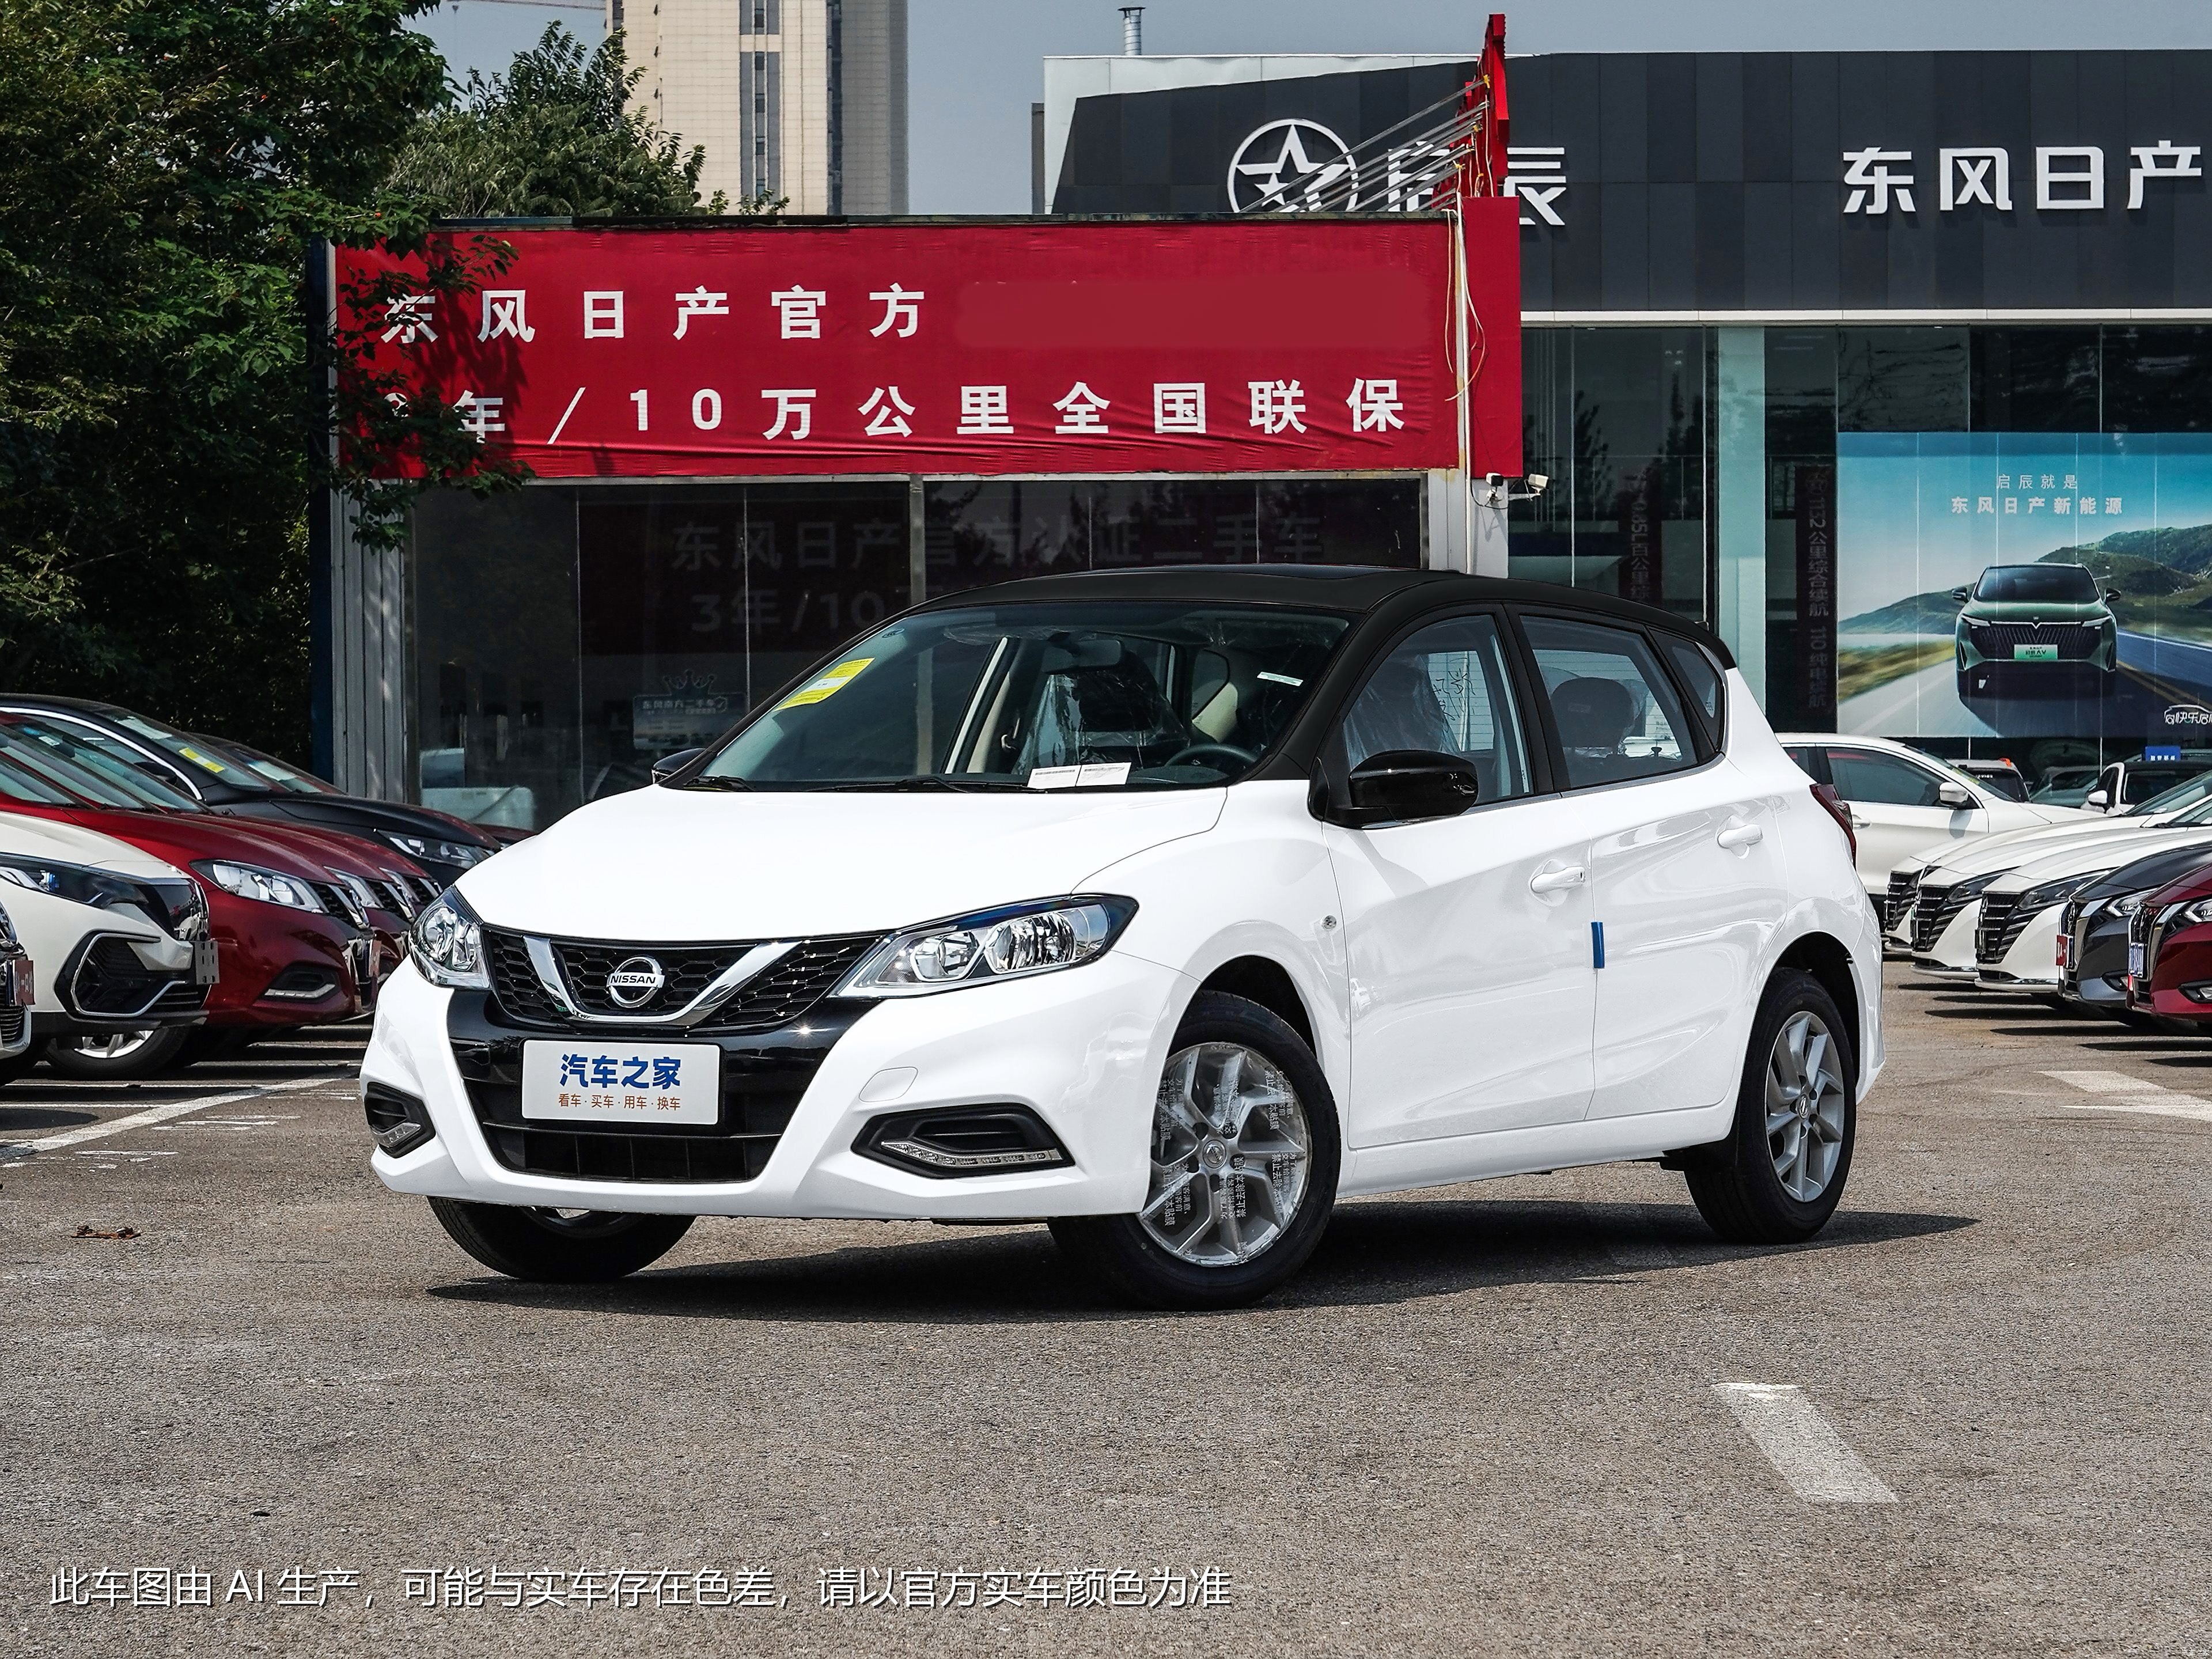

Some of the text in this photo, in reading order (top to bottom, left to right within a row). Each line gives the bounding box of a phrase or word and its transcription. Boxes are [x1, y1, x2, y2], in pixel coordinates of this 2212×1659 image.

[1843, 139, 2202, 214] 东风日产
[381, 282, 925, 343] 东风日产官方
[1997, 474, 2077, 489] 启辰就是
[1951, 496, 2122, 514] 东风日产新能源
[610, 975, 656, 984] NISSAN
[559, 1054, 681, 1090] 汽车之家
